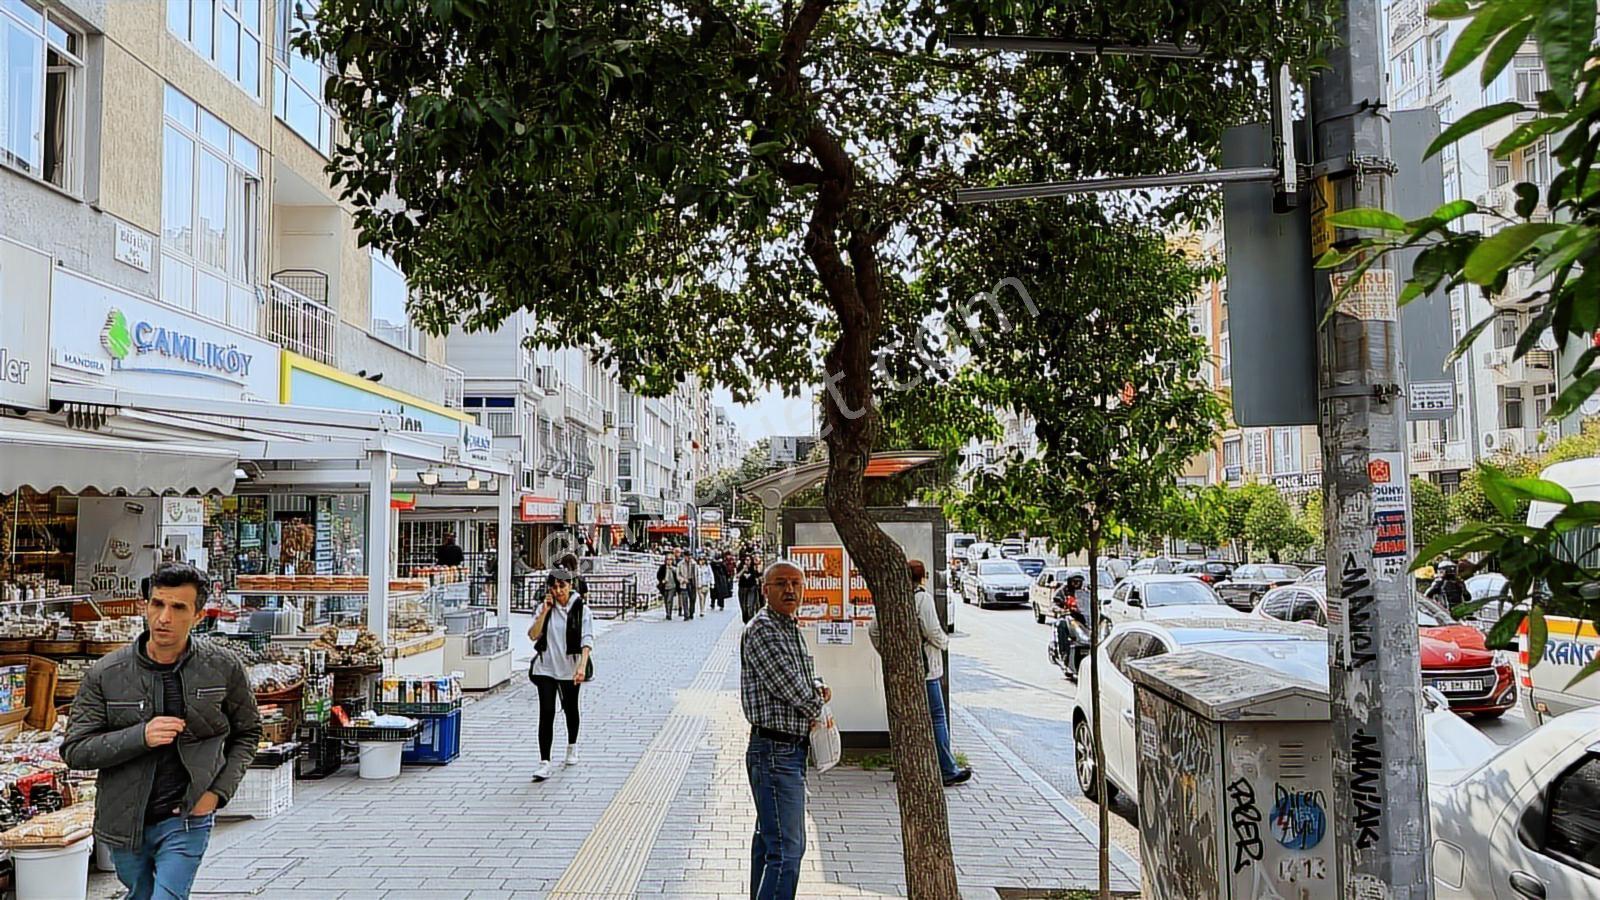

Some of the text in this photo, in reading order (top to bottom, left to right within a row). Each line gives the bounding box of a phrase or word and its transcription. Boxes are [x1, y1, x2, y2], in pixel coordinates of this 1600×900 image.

[134, 321, 253, 377] ÇAMLIKÖY
[64, 353, 105, 372] MANDIRA
[804, 576, 842, 590] YÜKTÜR!
[850, 575, 868, 590] BÜY
[1543, 640, 1596, 666] RANS
